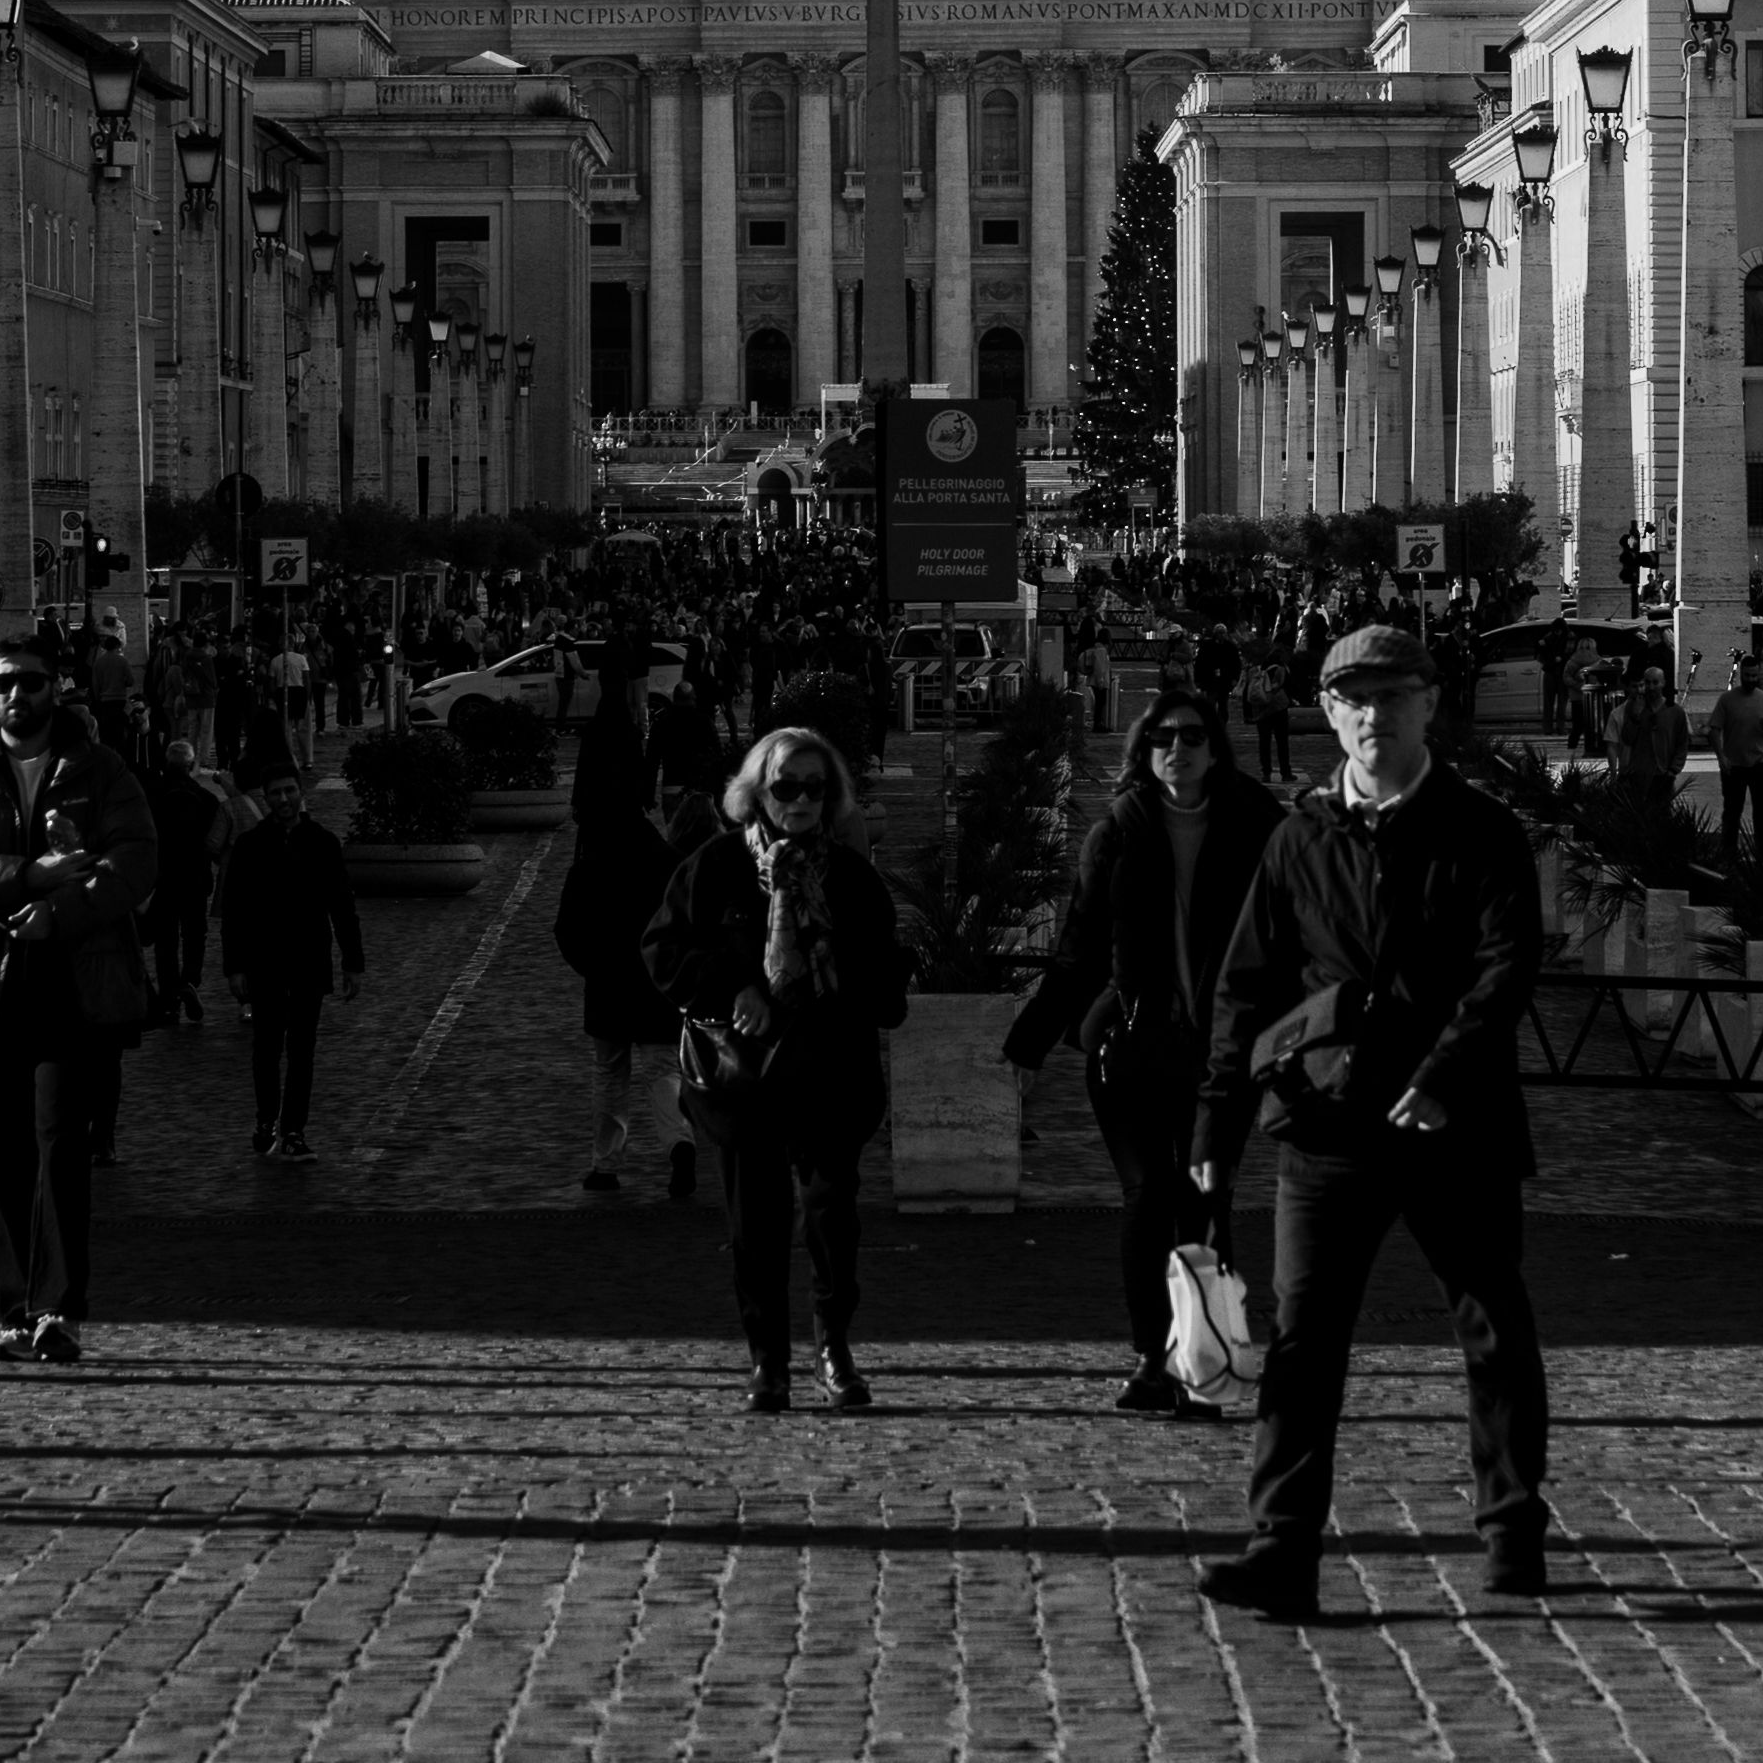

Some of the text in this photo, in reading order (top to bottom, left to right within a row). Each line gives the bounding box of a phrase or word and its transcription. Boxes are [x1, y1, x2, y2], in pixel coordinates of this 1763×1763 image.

[391, 9, 506, 26] HONOREM
[512, 8, 626, 25] PRINCIPIS
[947, 3, 1061, 21] ROMANVS
[1215, 2, 1303, 20] MDCXII
[1310, 1, 1370, 19] PONT
[899, 478, 1005, 490] PELLEGRINAGGIO
[892, 492, 1011, 504] ALLA PORTA SANTA
[920, 548, 985, 560] HOLY DOOR
[916, 564, 989, 576] PILGRIMAGE
